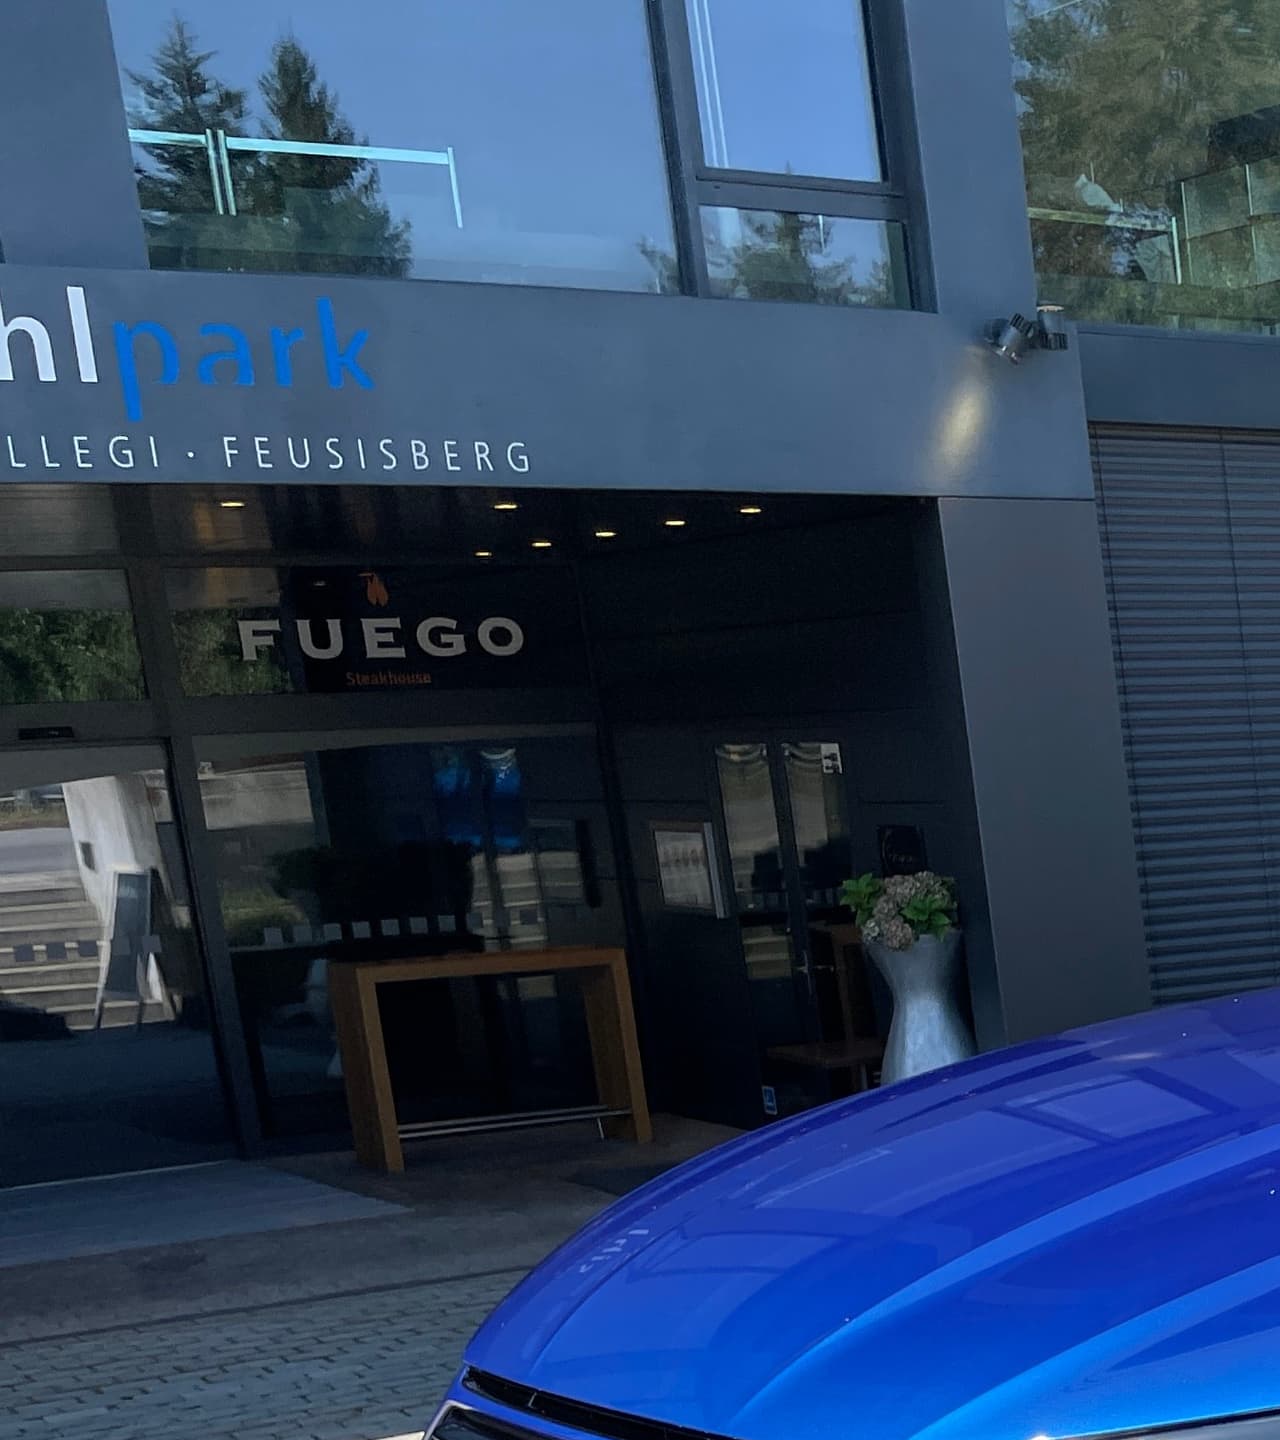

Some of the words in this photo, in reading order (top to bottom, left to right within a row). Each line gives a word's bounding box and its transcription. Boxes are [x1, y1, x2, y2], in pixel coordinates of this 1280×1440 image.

[6, 435, 159, 468] LLEGI
[223, 436, 531, 473] FEUSISBERG
[238, 616, 524, 661] FUEGO
[345, 670, 433, 687] Steakhouse
